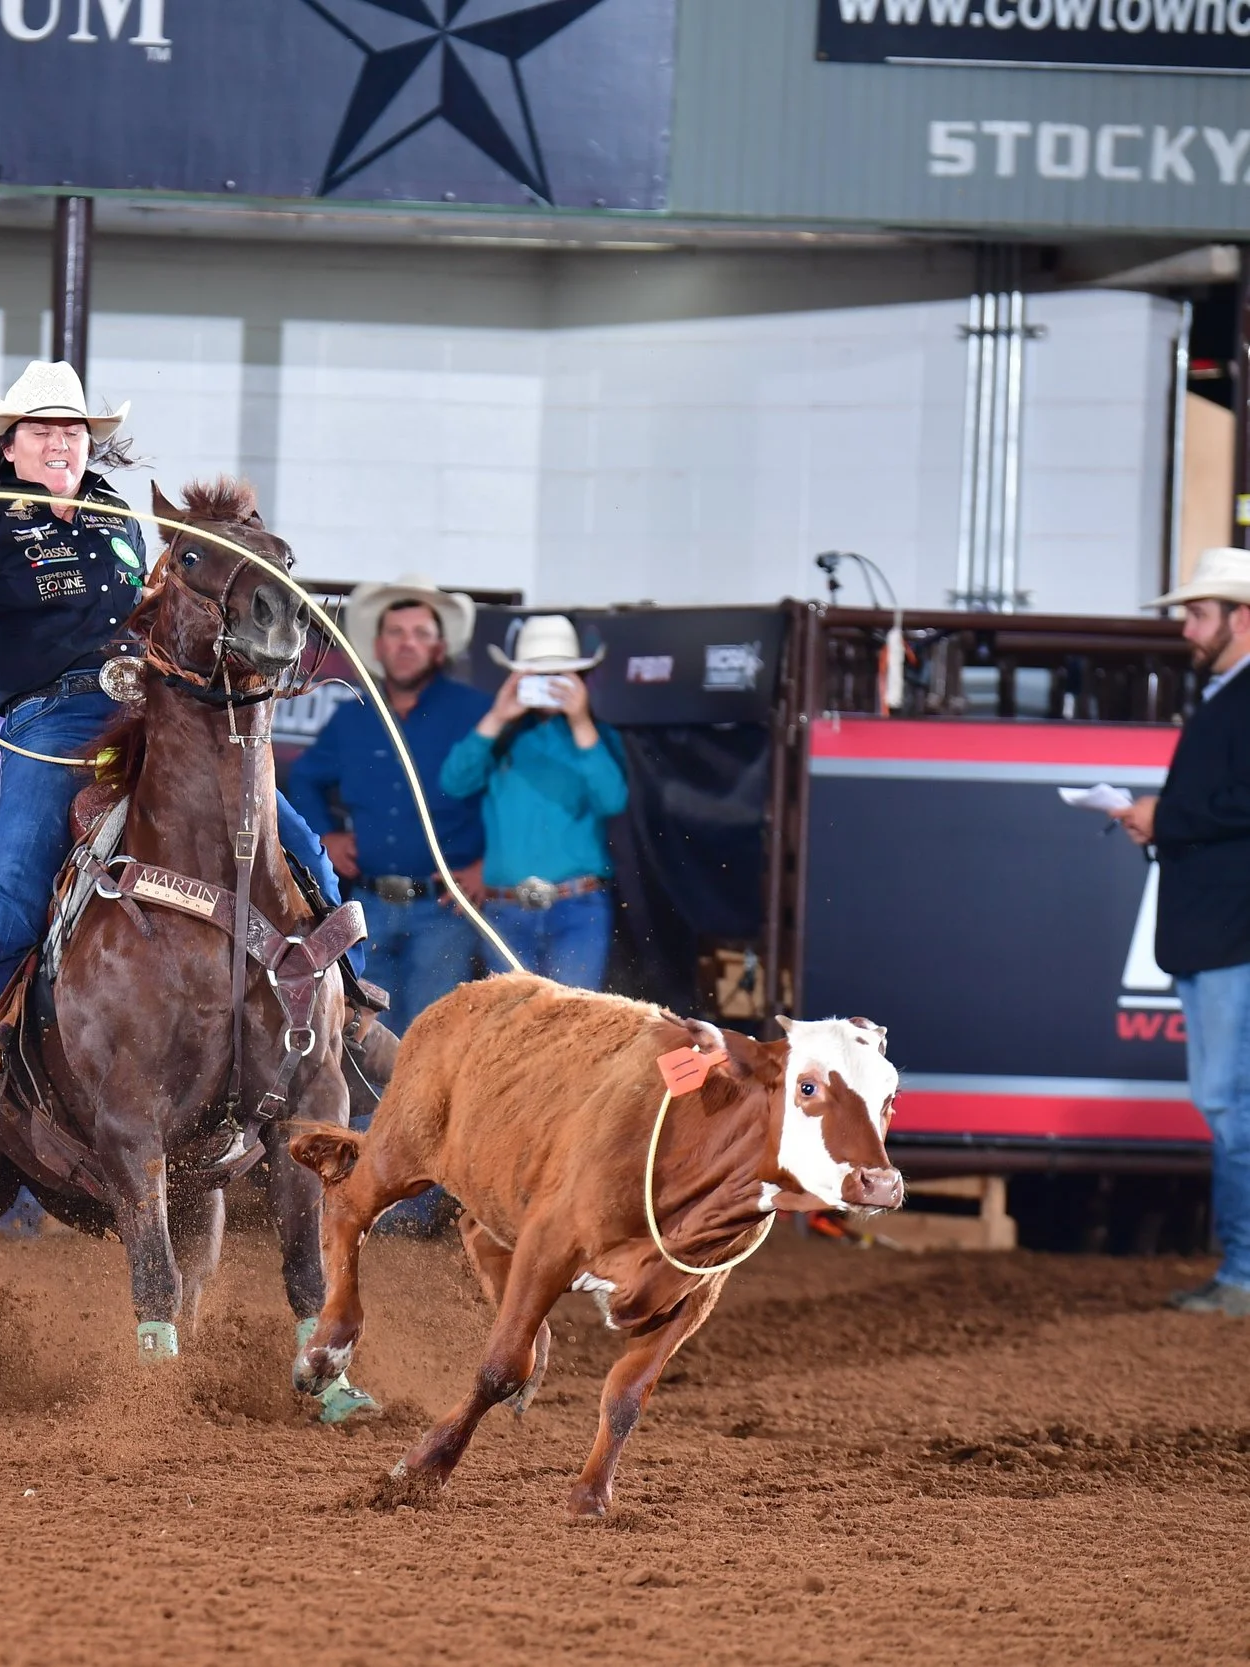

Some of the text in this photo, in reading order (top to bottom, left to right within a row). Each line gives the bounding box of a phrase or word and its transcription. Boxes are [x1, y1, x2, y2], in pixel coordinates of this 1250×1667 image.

[928, 120, 1250, 184] STOCKY
[24, 541, 77, 561] Classic
[38, 576, 86, 595] EQUINE
[137, 868, 220, 905] MARTIN
